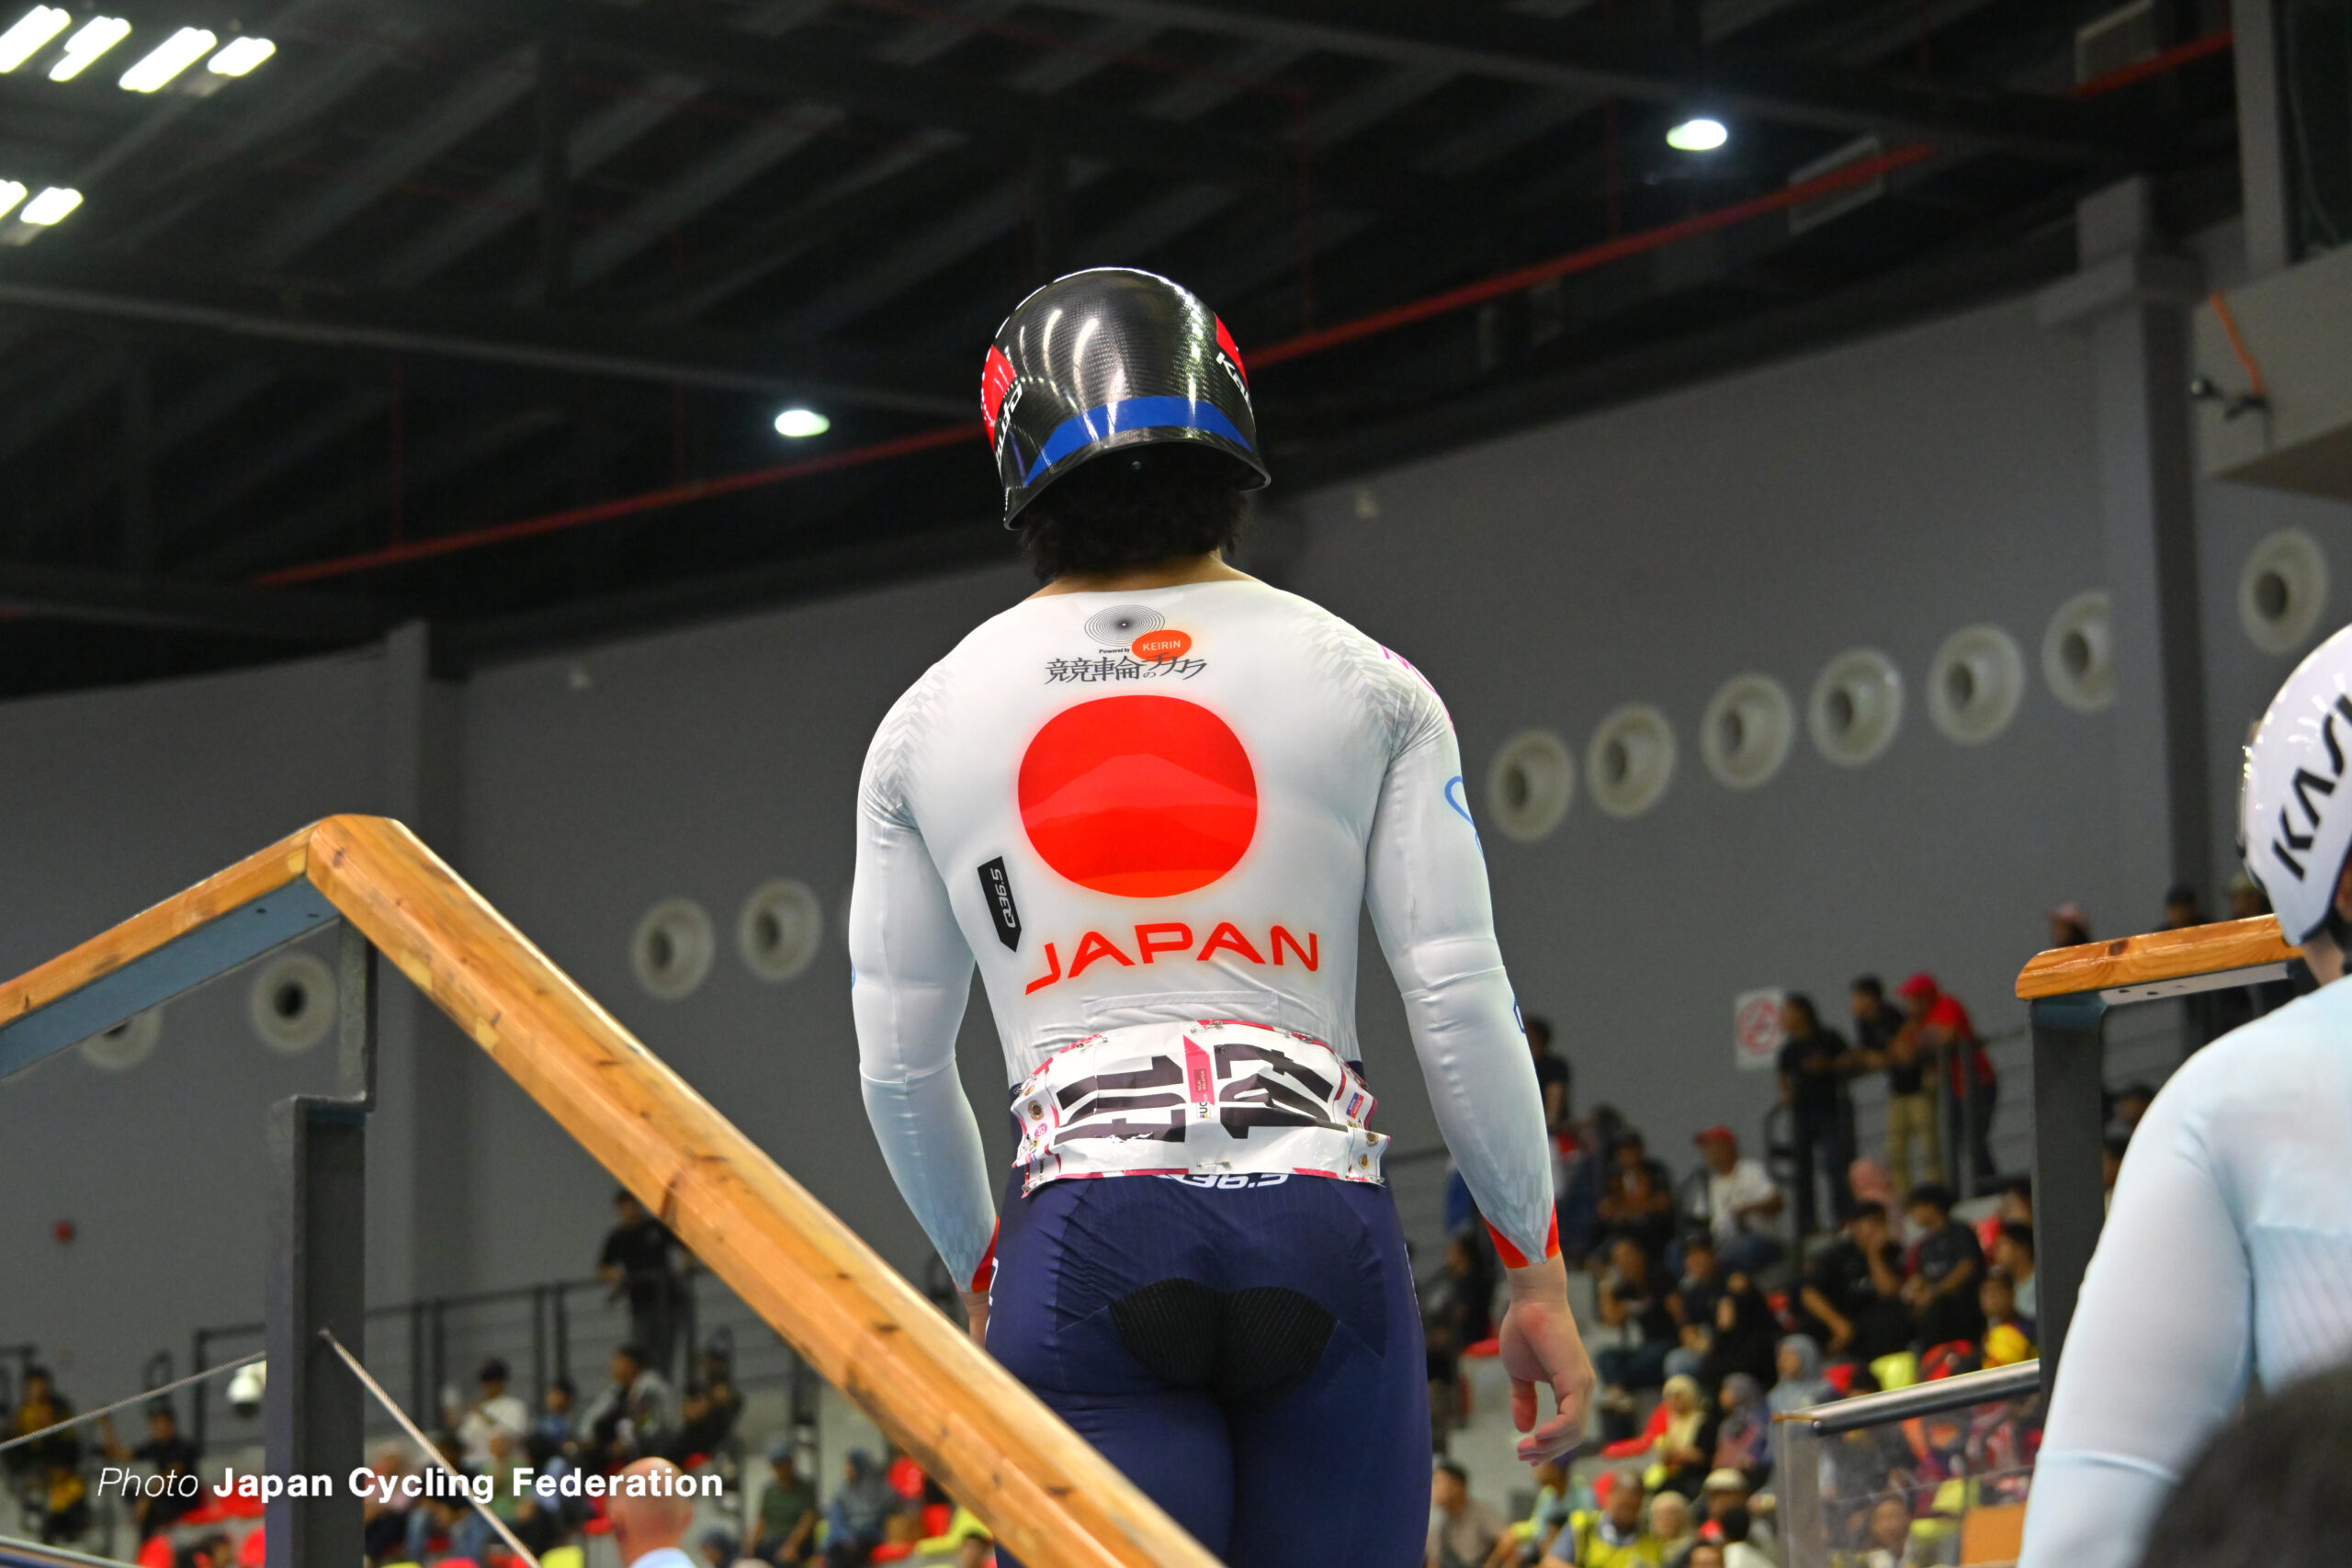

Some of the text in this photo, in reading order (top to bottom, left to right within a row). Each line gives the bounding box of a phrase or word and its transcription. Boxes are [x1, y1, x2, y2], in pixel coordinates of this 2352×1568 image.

[1142, 640, 1182, 651] KEIRIN
[989, 867, 1017, 929] Q36.5
[1024, 921, 1318, 996] JAPAN
